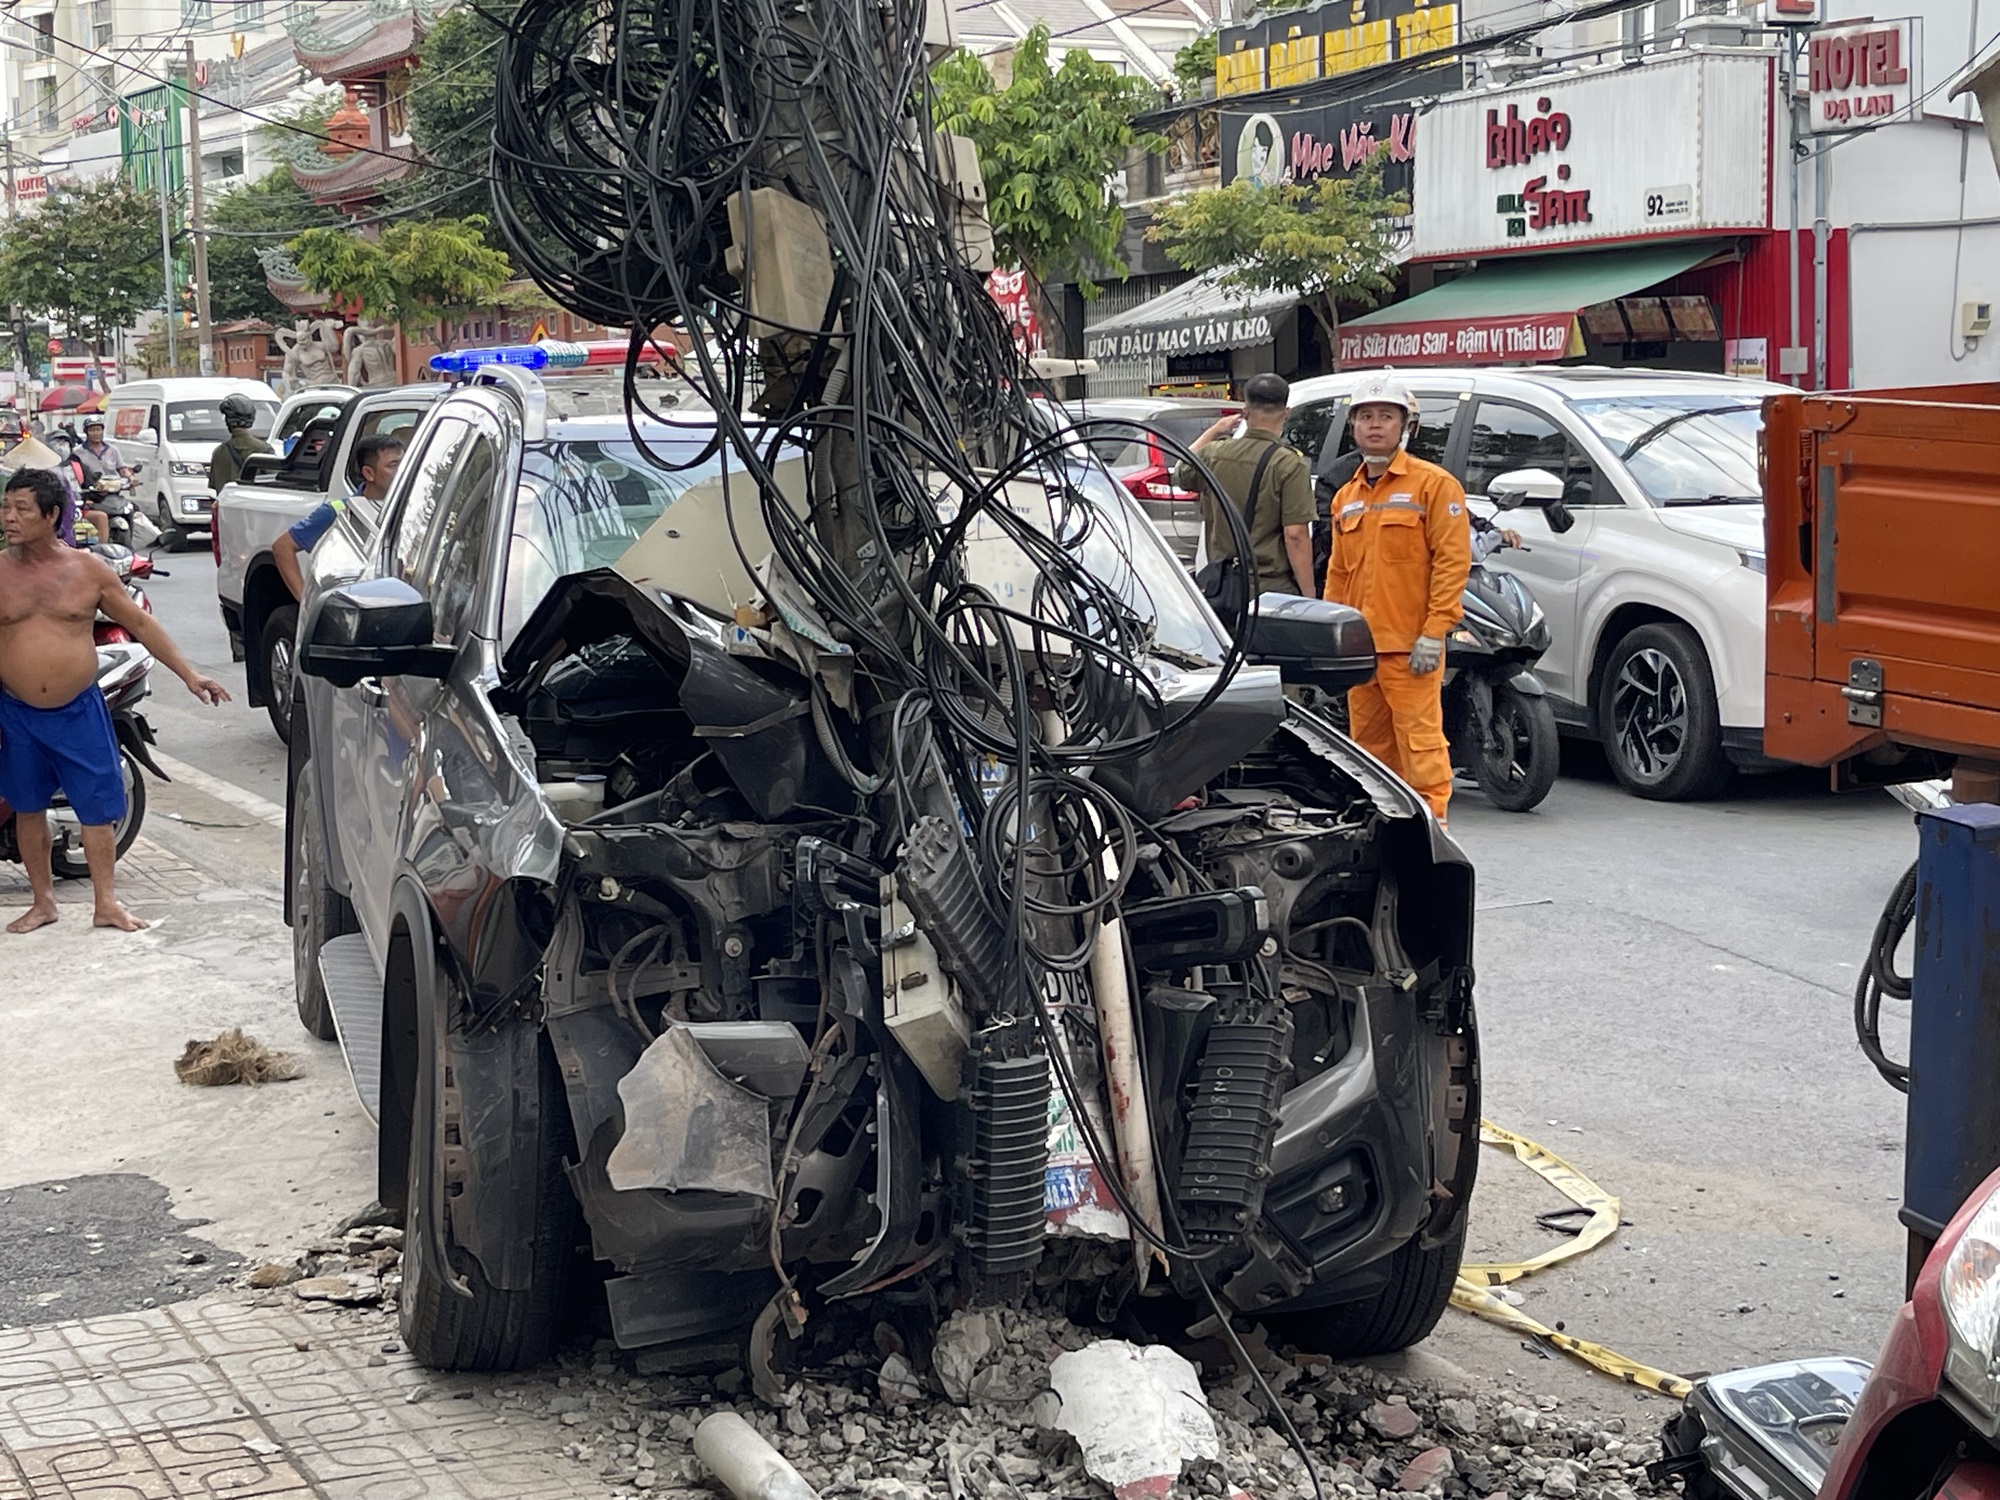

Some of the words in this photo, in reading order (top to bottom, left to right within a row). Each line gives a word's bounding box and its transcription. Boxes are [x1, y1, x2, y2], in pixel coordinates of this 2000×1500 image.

[1809, 29, 1907, 93] HOTEL
[1824, 99, 1851, 125] DẠ
[1854, 94, 1894, 119] LAN
[1647, 194, 1664, 217] 92
[1088, 333, 1118, 359] BÚN
[1121, 329, 1154, 359] ĐẬU
[1156, 328, 1191, 355] MẠC
[1194, 318, 1229, 346] VĂN
[1341, 334, 1361, 360] Trà
[1362, 333, 1387, 358] Sữa
[1388, 334, 1420, 357] Khao
[1422, 331, 1448, 355] San
[1456, 326, 1488, 359] Đậm
[1490, 328, 1504, 357] Vị
[1506, 323, 1537, 352] Thái
[1539, 326, 1566, 350] Lan
